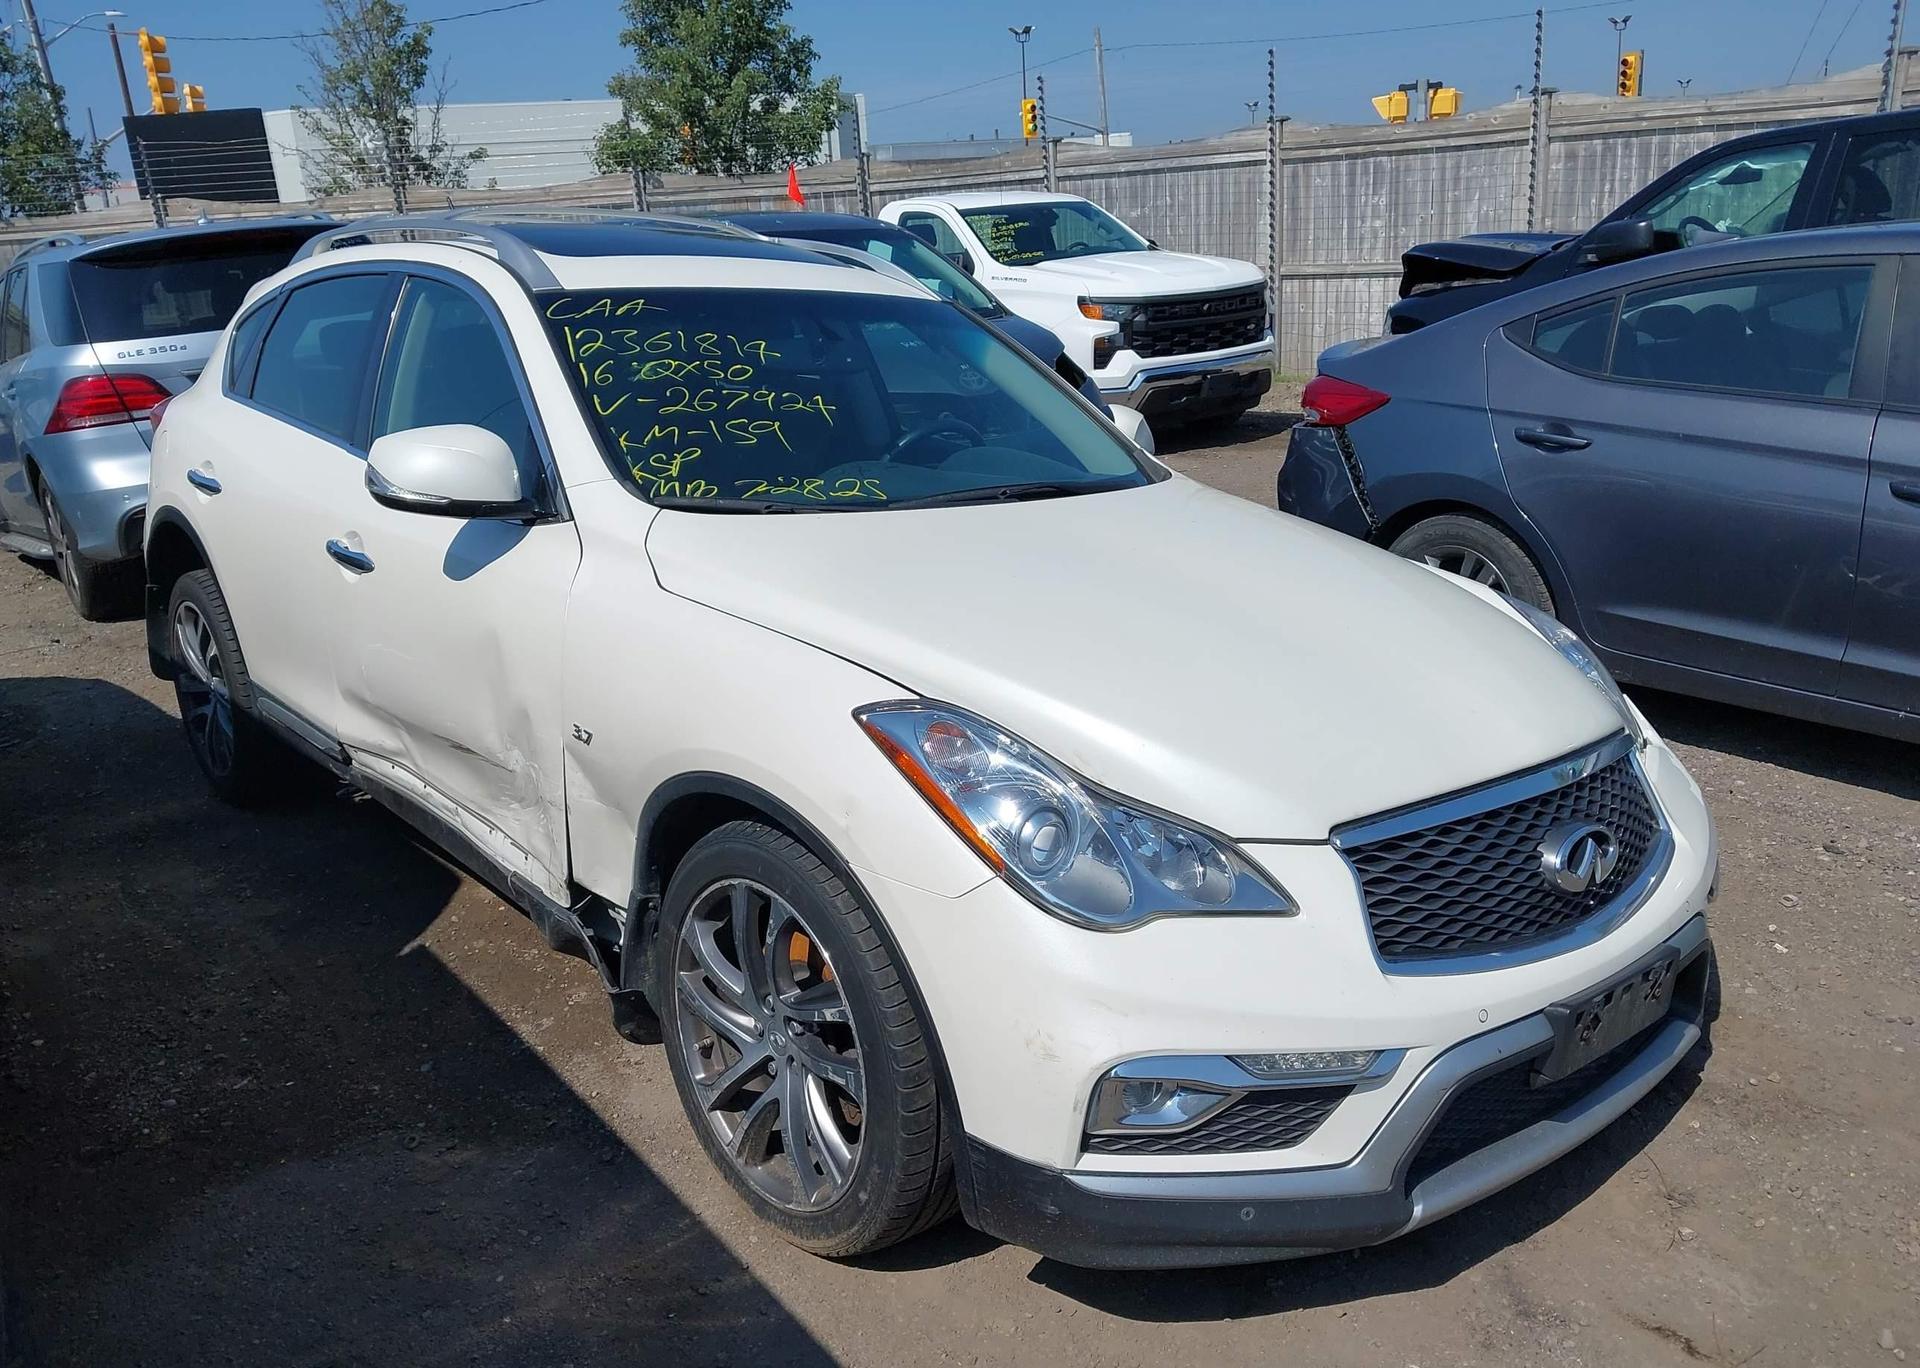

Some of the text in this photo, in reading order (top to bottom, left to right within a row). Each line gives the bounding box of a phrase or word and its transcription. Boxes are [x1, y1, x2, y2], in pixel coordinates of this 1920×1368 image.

[546, 297, 669, 319] CAA
[117, 349, 145, 359] GLE
[578, 359, 614, 389] 16
